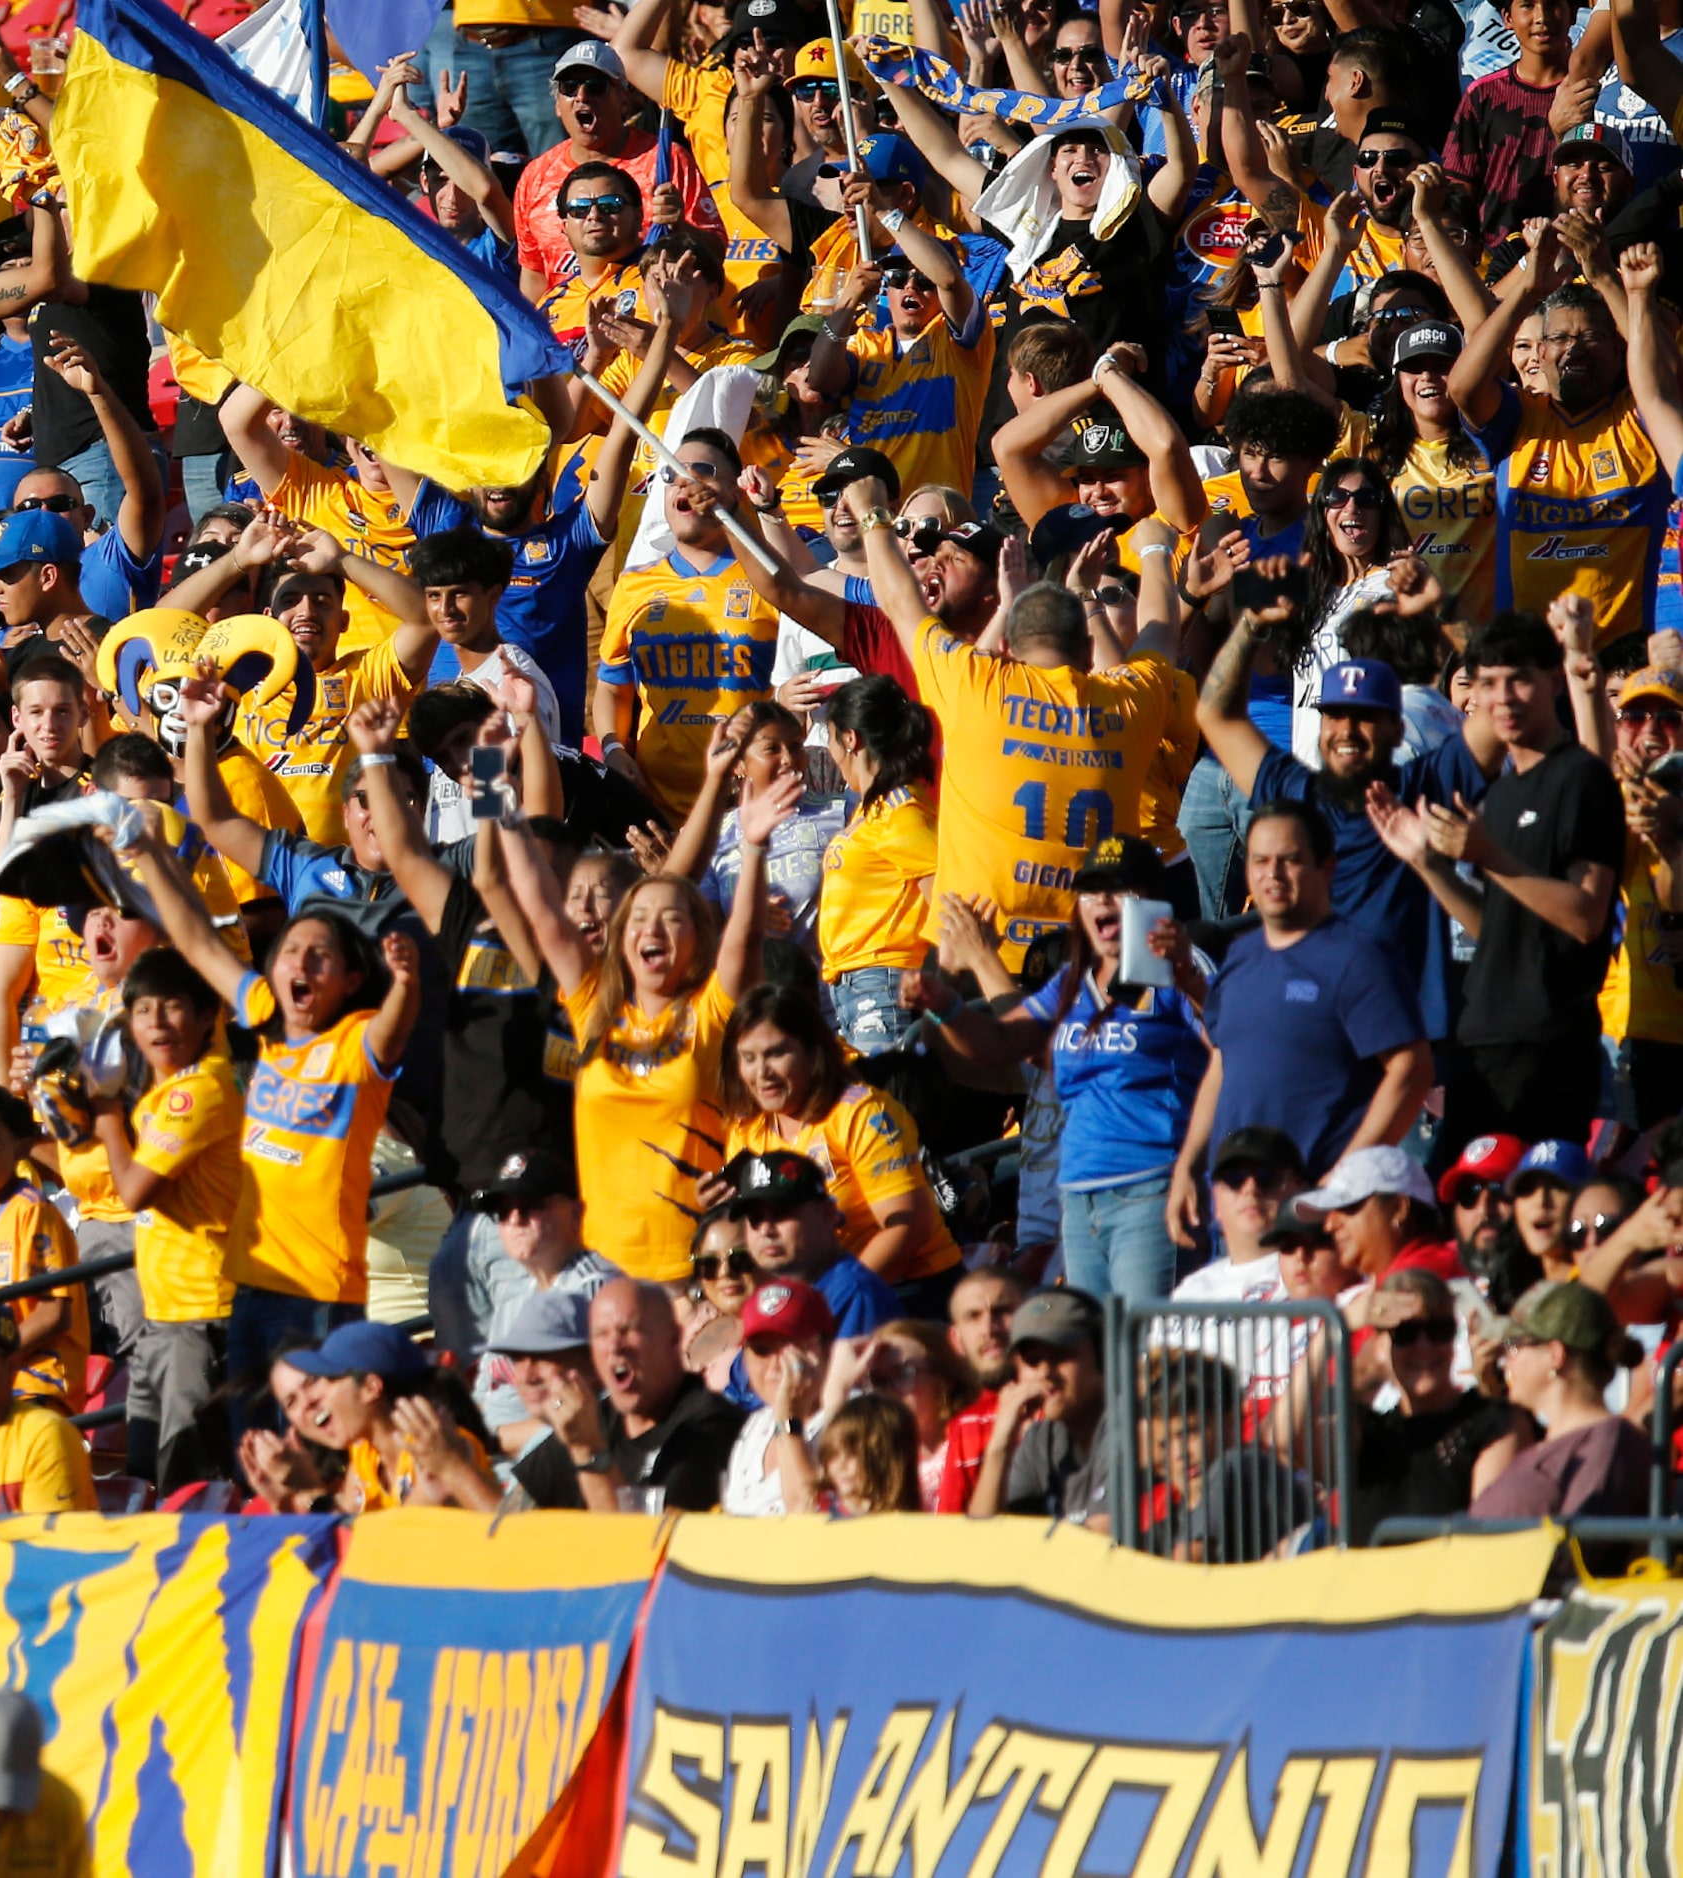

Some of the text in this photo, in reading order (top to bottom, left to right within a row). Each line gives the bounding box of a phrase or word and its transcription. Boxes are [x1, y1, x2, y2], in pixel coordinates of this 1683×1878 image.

[861, 13, 913, 35] TIGRE
[1477, 18, 1521, 56] TIG
[1288, 120, 1317, 135] CEM
[1199, 232, 1252, 248] BLAN
[1209, 221, 1246, 237] CAR
[726, 240, 778, 260] GRES
[1409, 329, 1447, 347] AFISCO
[1403, 484, 1497, 521] GRES
[1516, 496, 1631, 525] TIGRES
[1429, 543, 1472, 555] CEMEX
[1555, 544, 1610, 560] CEMEX
[636, 643, 751, 679] TIGRES
[243, 714, 350, 744] TIGRES
[1004, 695, 1104, 739] TECATE
[281, 762, 332, 776] CEMEX
[1041, 748, 1120, 769] AFIRME
[1013, 780, 1114, 848] 10
[767, 853, 820, 884] RES
[1015, 859, 1074, 889] GIGN
[251, 1074, 335, 1129] GRES
[256, 1142, 302, 1164] CEMEX
[617, 1700, 851, 1878] SAN
[821, 1694, 1485, 1878] ANTONIO
